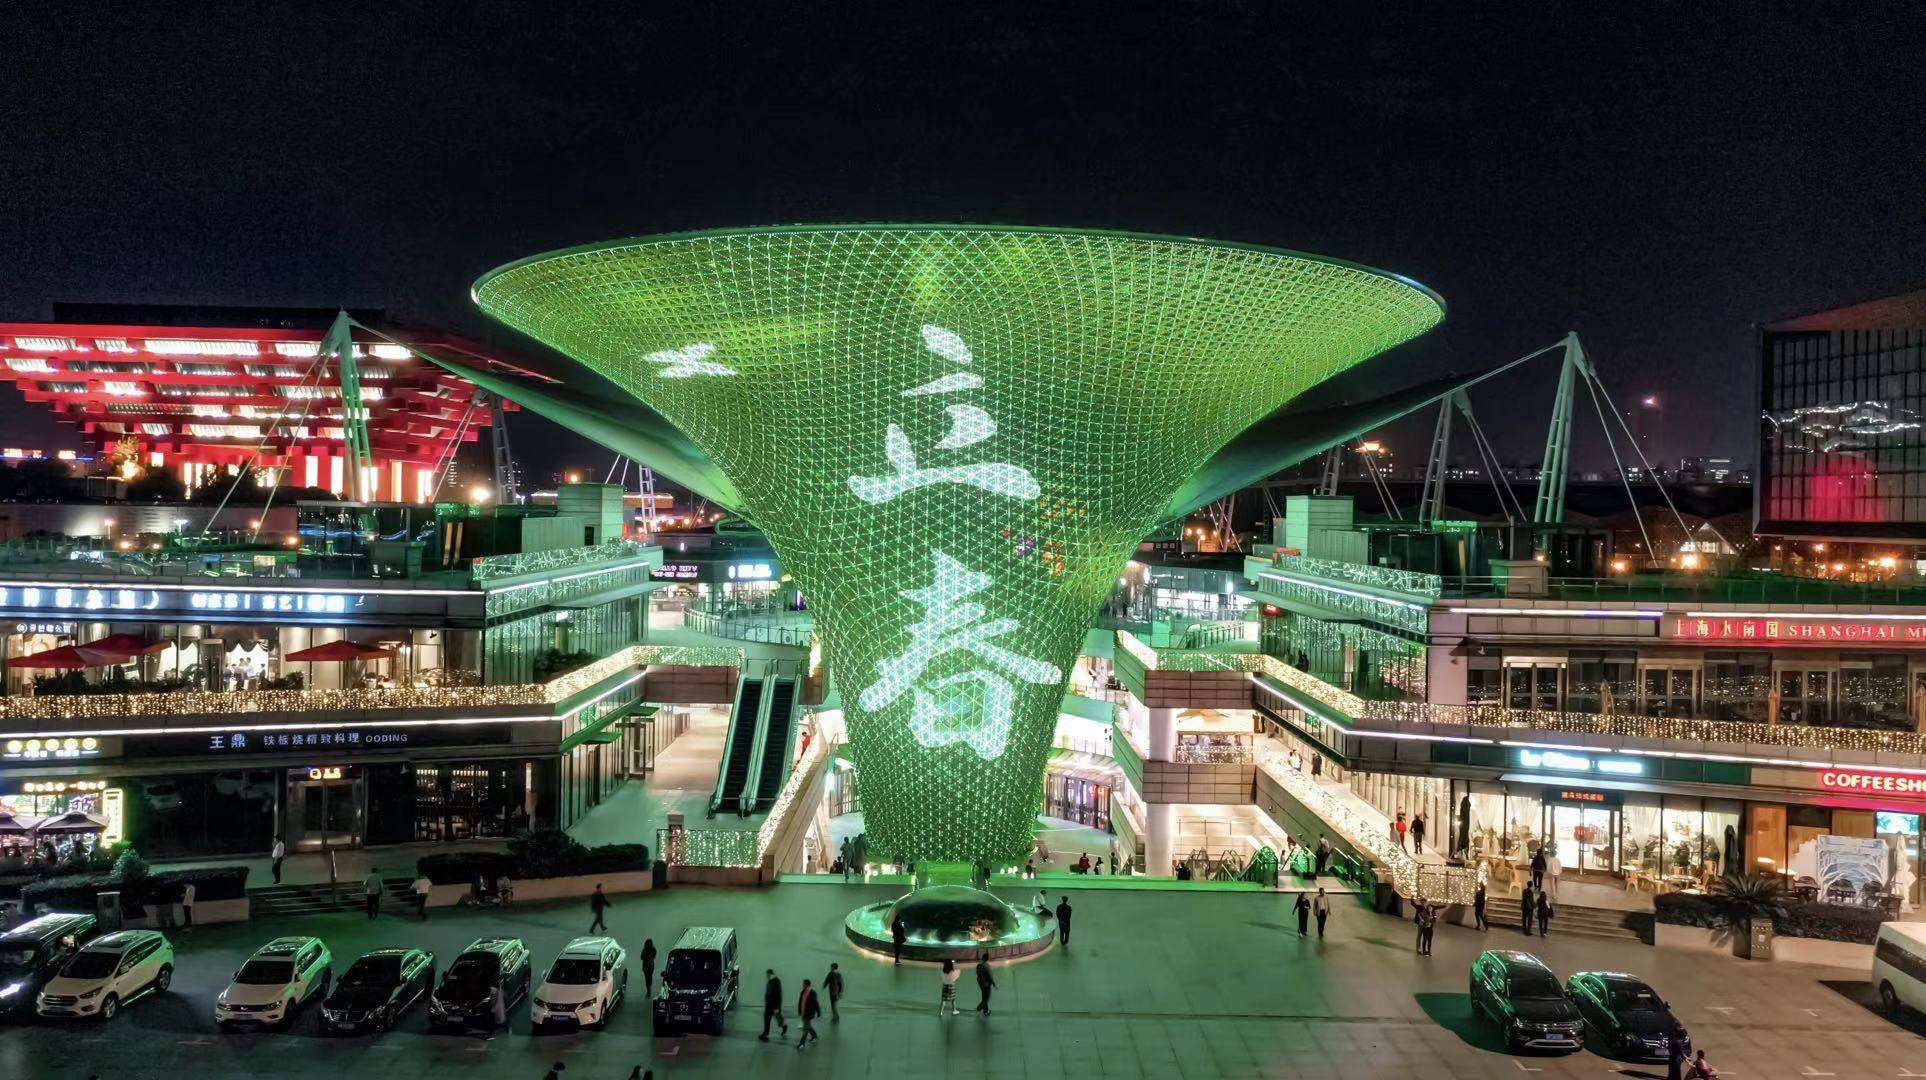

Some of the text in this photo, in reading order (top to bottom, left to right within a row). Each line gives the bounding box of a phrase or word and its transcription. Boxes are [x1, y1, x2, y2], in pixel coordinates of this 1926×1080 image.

[1788, 624, 1896, 639] SHANGHAI
[209, 732, 409, 750] 王鼎 铁板烧精致料理 OODING
